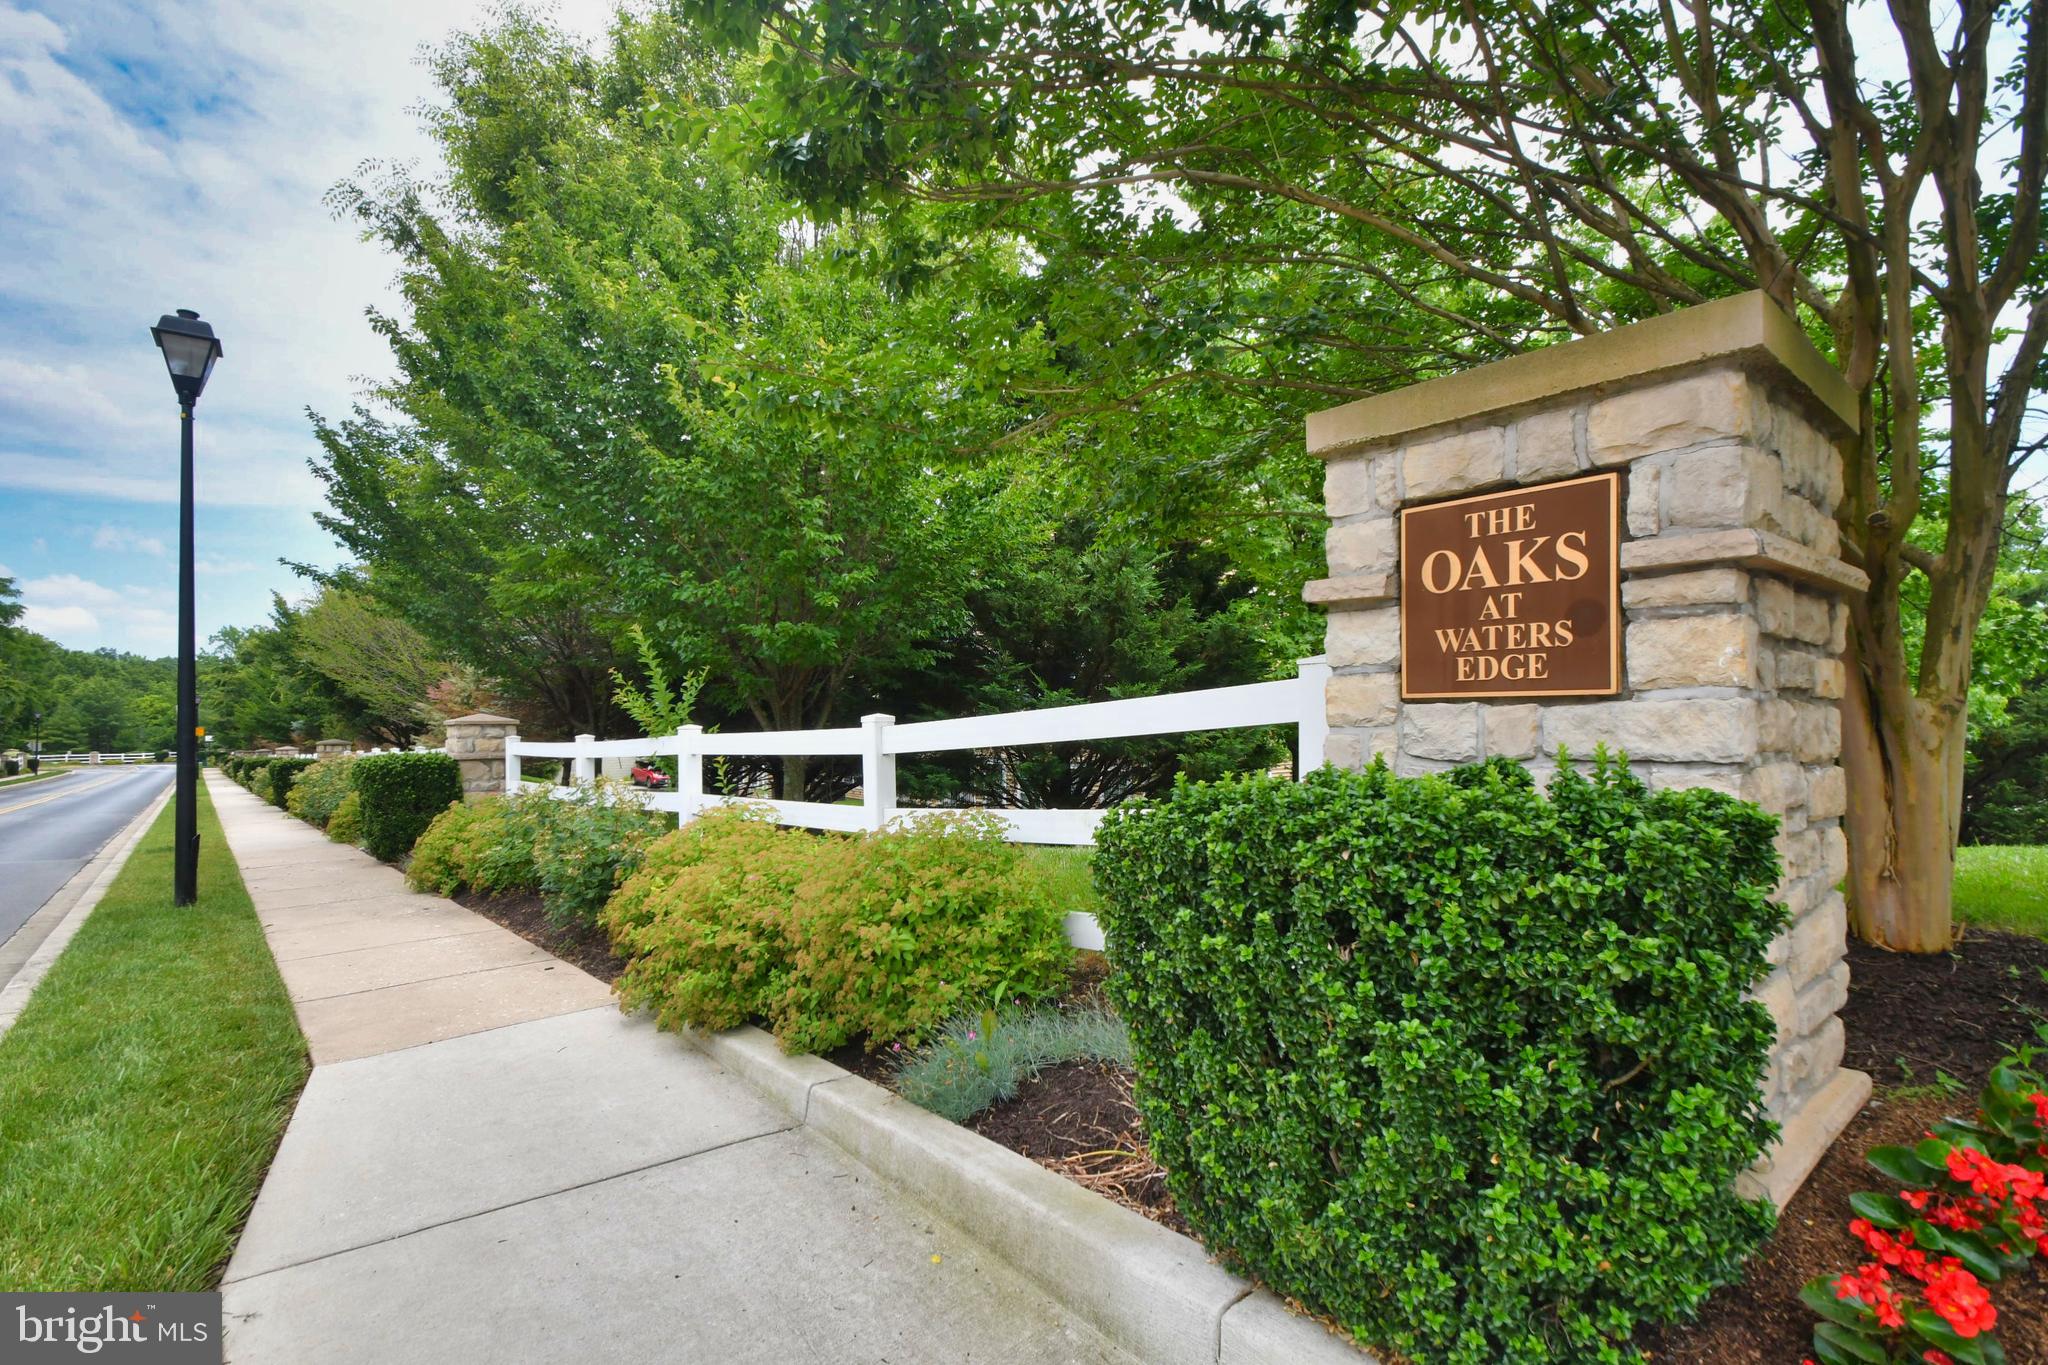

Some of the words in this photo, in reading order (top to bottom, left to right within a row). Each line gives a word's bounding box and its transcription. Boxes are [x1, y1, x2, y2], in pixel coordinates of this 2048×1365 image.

[1465, 503, 1536, 538] THE
[1421, 530, 1589, 594] OAKS
[1479, 592, 1522, 620] AT
[1434, 619, 1573, 653] WATERS
[1456, 653, 1549, 681] EDGE
